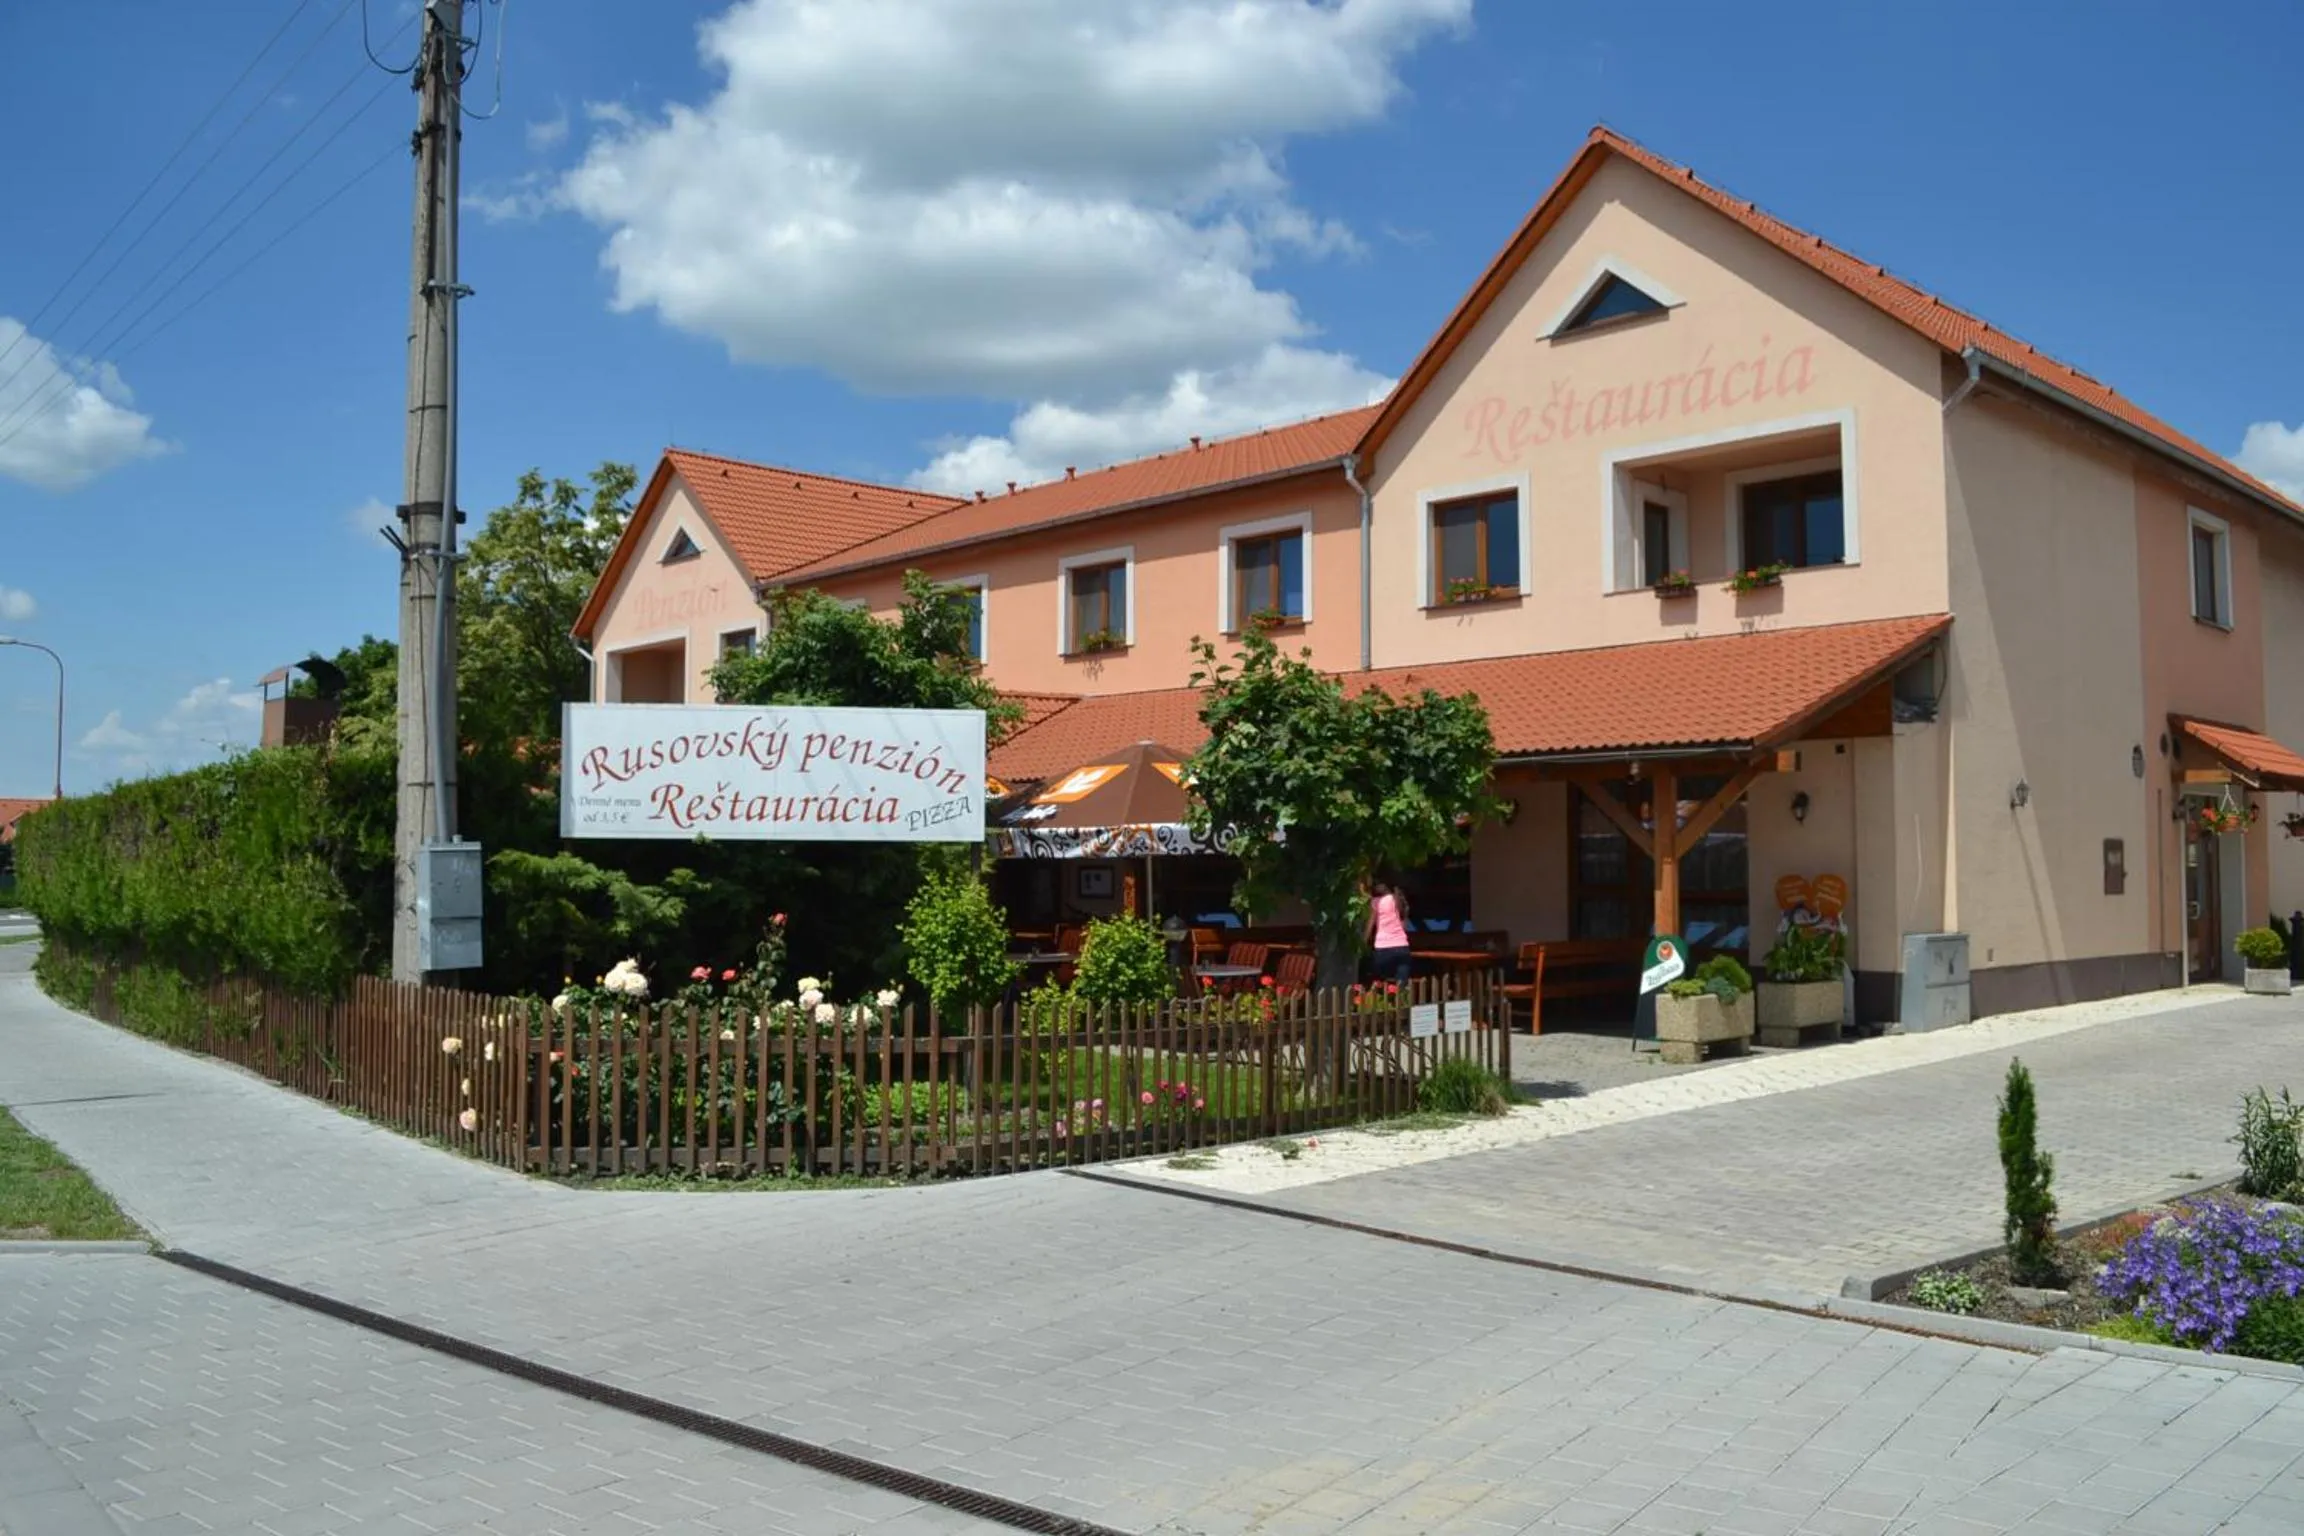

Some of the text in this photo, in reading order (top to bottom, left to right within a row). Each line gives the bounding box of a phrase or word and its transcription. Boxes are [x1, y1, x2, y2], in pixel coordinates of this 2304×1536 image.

[1461, 333, 1819, 464] Reštaurácia
[581, 716, 967, 794] Rusovský penzión
[648, 781, 900, 829] Reštaurácia
[905, 796, 972, 832] PIZZA
